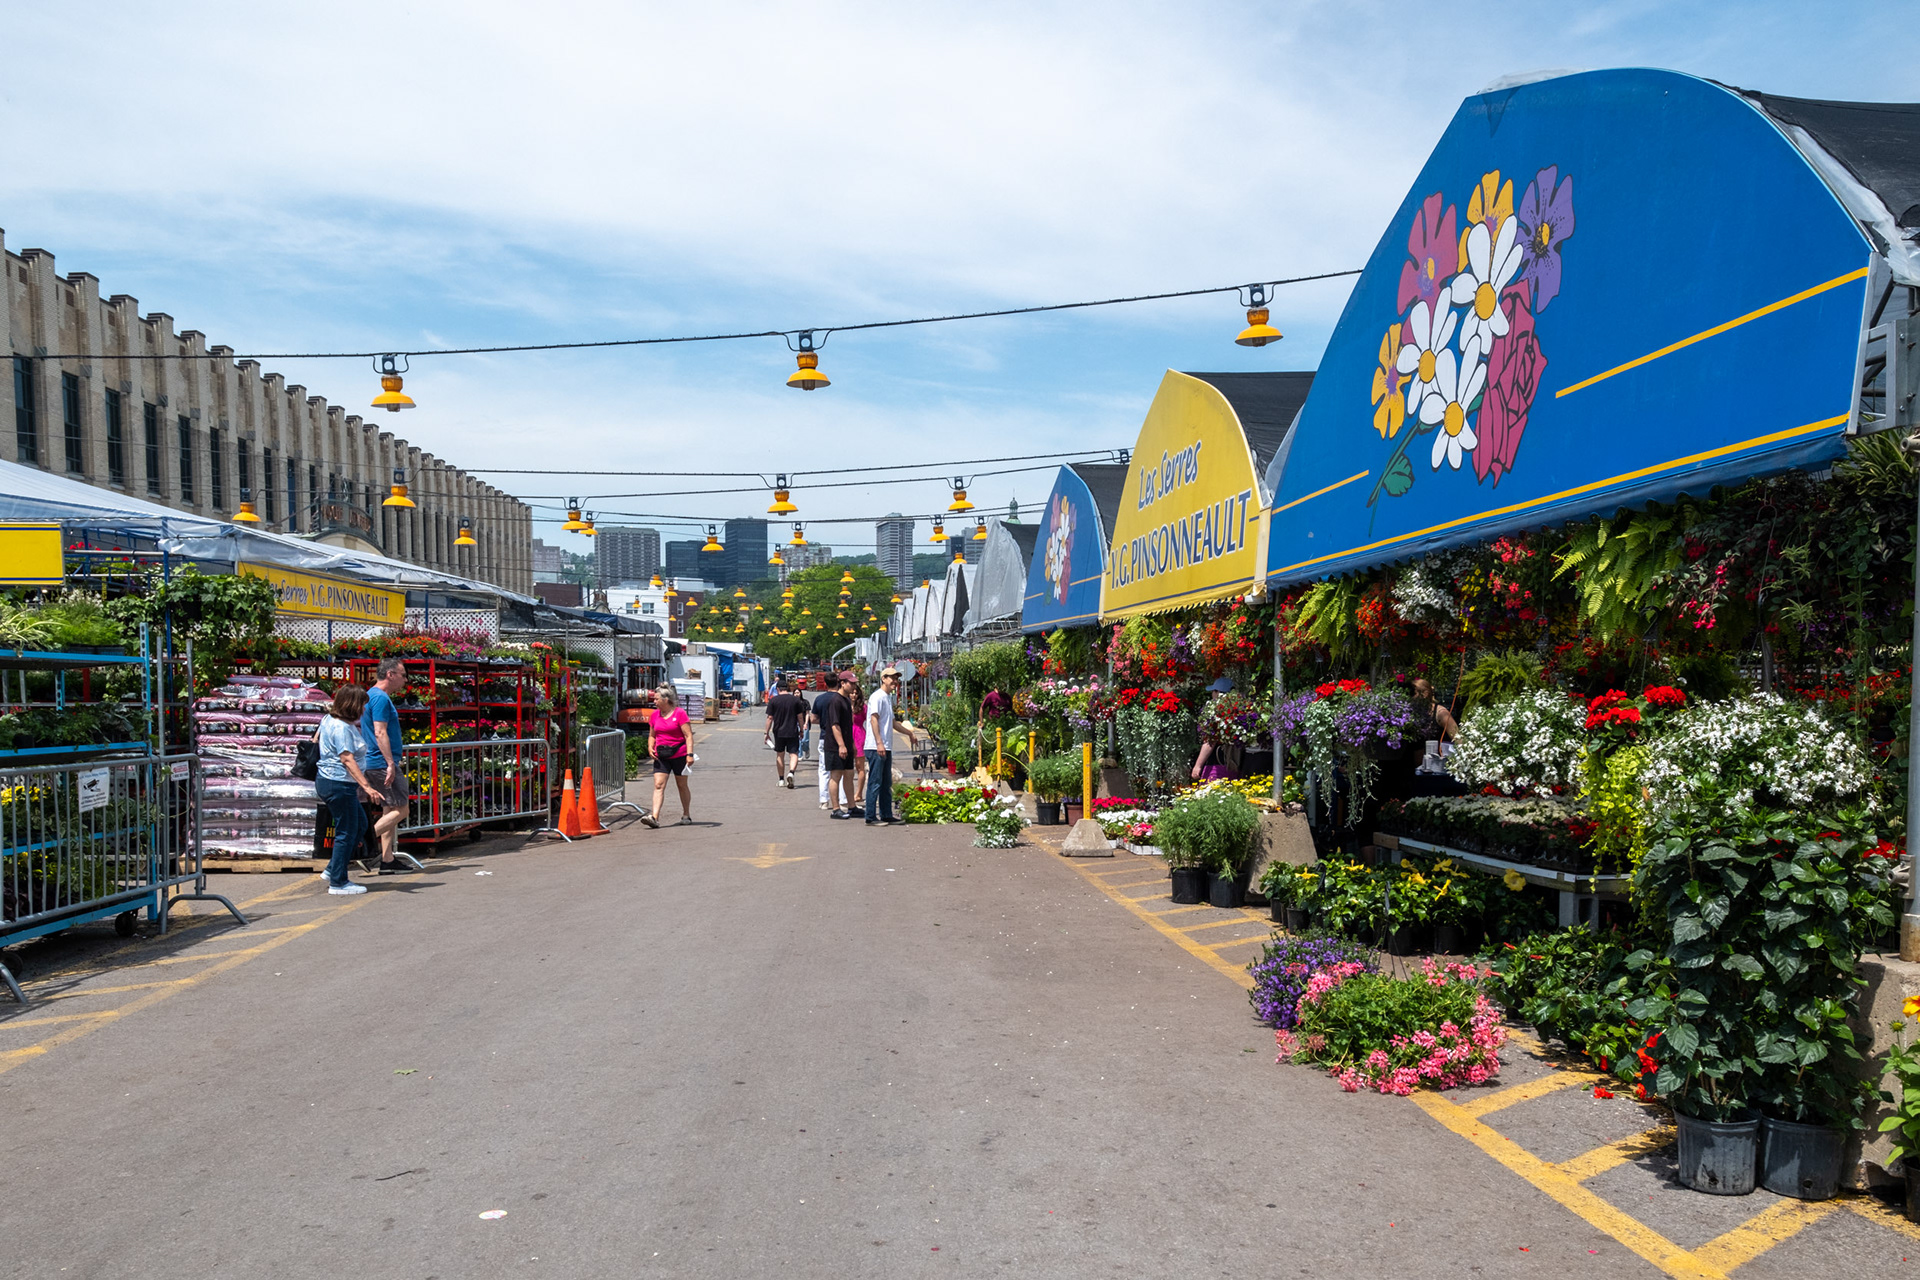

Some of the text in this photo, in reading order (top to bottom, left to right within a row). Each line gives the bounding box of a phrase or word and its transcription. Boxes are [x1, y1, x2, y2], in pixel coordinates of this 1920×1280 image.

[1138, 440, 1202, 512] Les Serres
[280, 579, 309, 606] Serres
